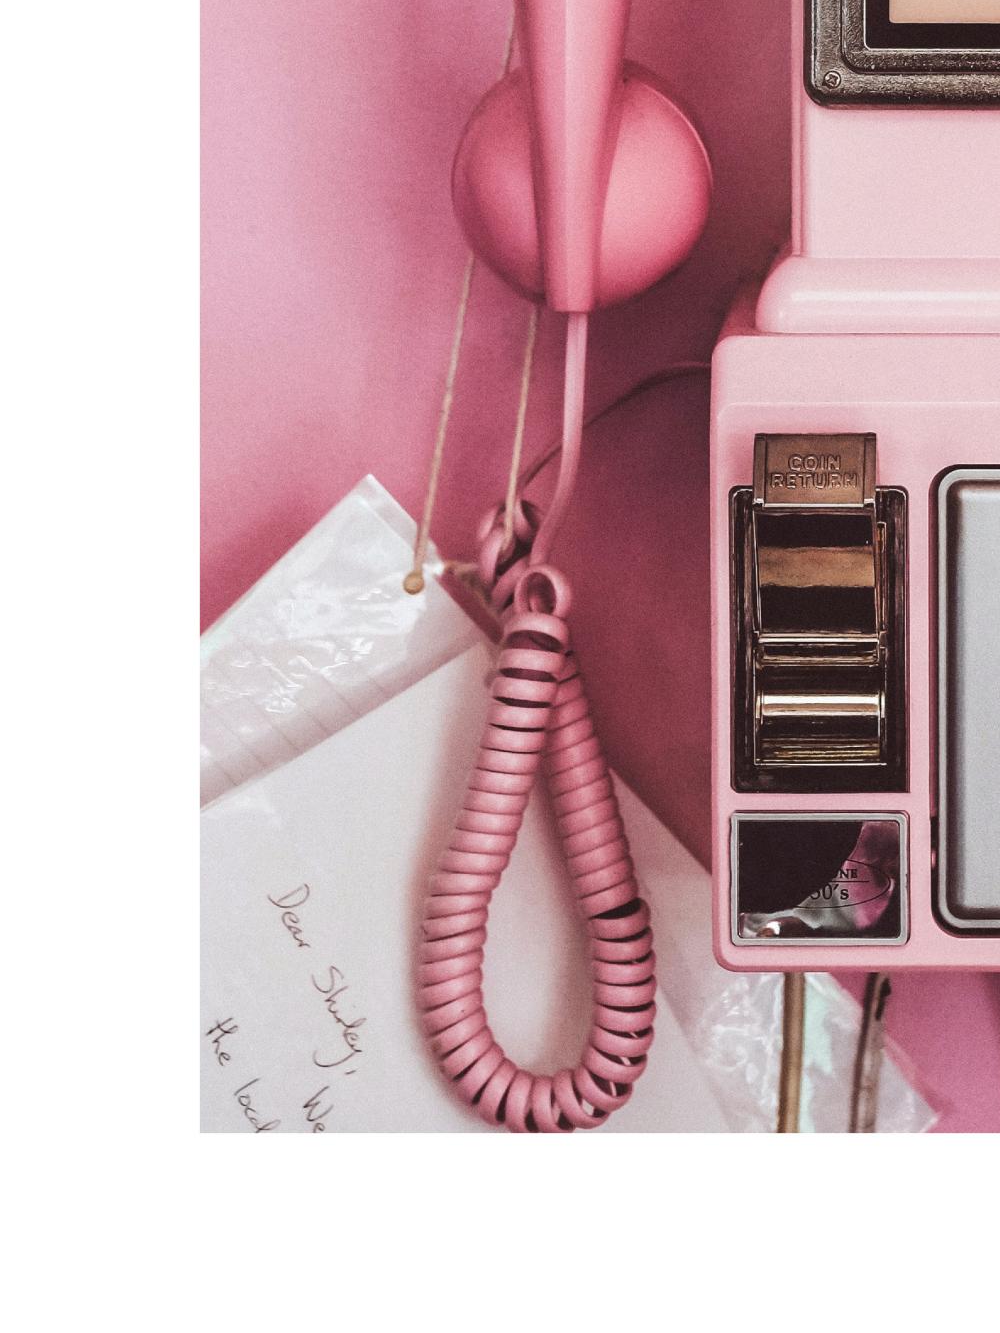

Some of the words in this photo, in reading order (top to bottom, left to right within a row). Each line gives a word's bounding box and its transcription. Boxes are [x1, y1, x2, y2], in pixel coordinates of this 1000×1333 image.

[788, 453, 841, 472] COIN
[770, 472, 858, 489] RETURN
[268, 884, 311, 947] Dear
[206, 1017, 239, 1066] the
